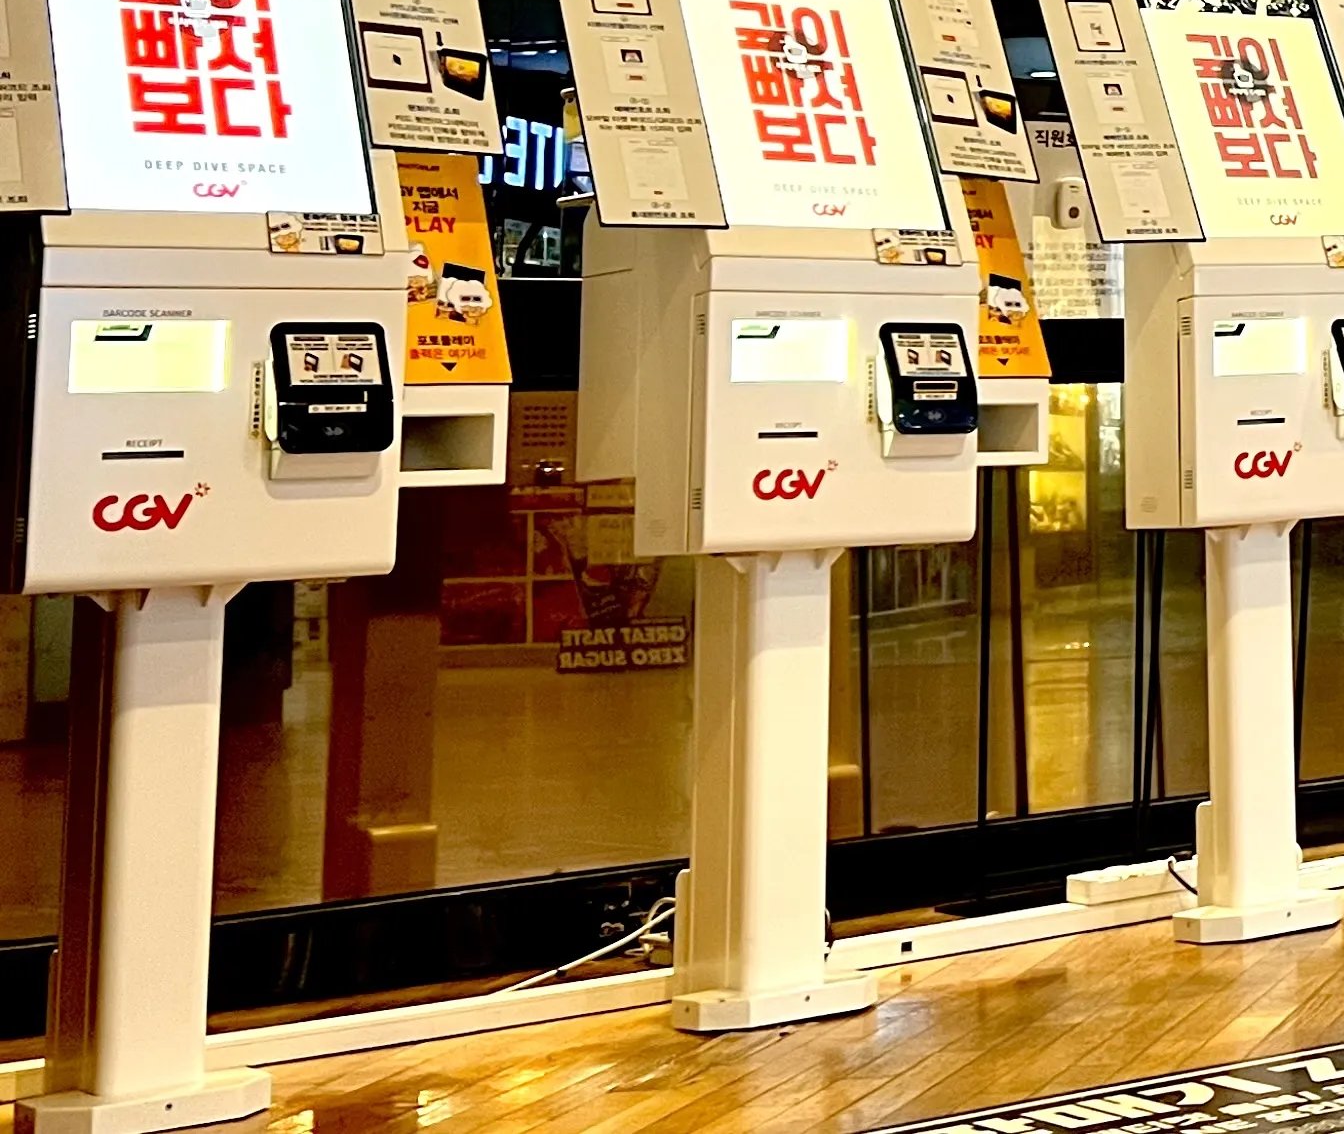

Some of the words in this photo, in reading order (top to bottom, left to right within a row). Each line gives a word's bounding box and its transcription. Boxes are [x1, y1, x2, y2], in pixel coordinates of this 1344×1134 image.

[120, 7, 280, 74] 빠져
[728, 0, 850, 59] 깊이
[1185, 33, 1288, 82] 깊이
[741, 55, 862, 113] 빠져
[130, 73, 293, 139] 보다
[1199, 81, 1303, 130] 빠져
[754, 109, 878, 167] 보다
[1212, 130, 1319, 181] 보다
[145, 159, 184, 172] DEEP
[193, 161, 229, 173] DIVE
[238, 163, 287, 175] SPACE
[192, 182, 241, 200] CGV
[412, 200, 440, 215] 지금
[812, 202, 847, 217] CGV
[1269, 213, 1297, 226] CGV
[103, 308, 146, 318] BARCODE
[149, 308, 193, 318] SCANNER
[126, 439, 163, 449] RECEIPT
[1233, 450, 1293, 479] CGV
[752, 468, 826, 501] CGV
[92, 493, 193, 532] CGV
